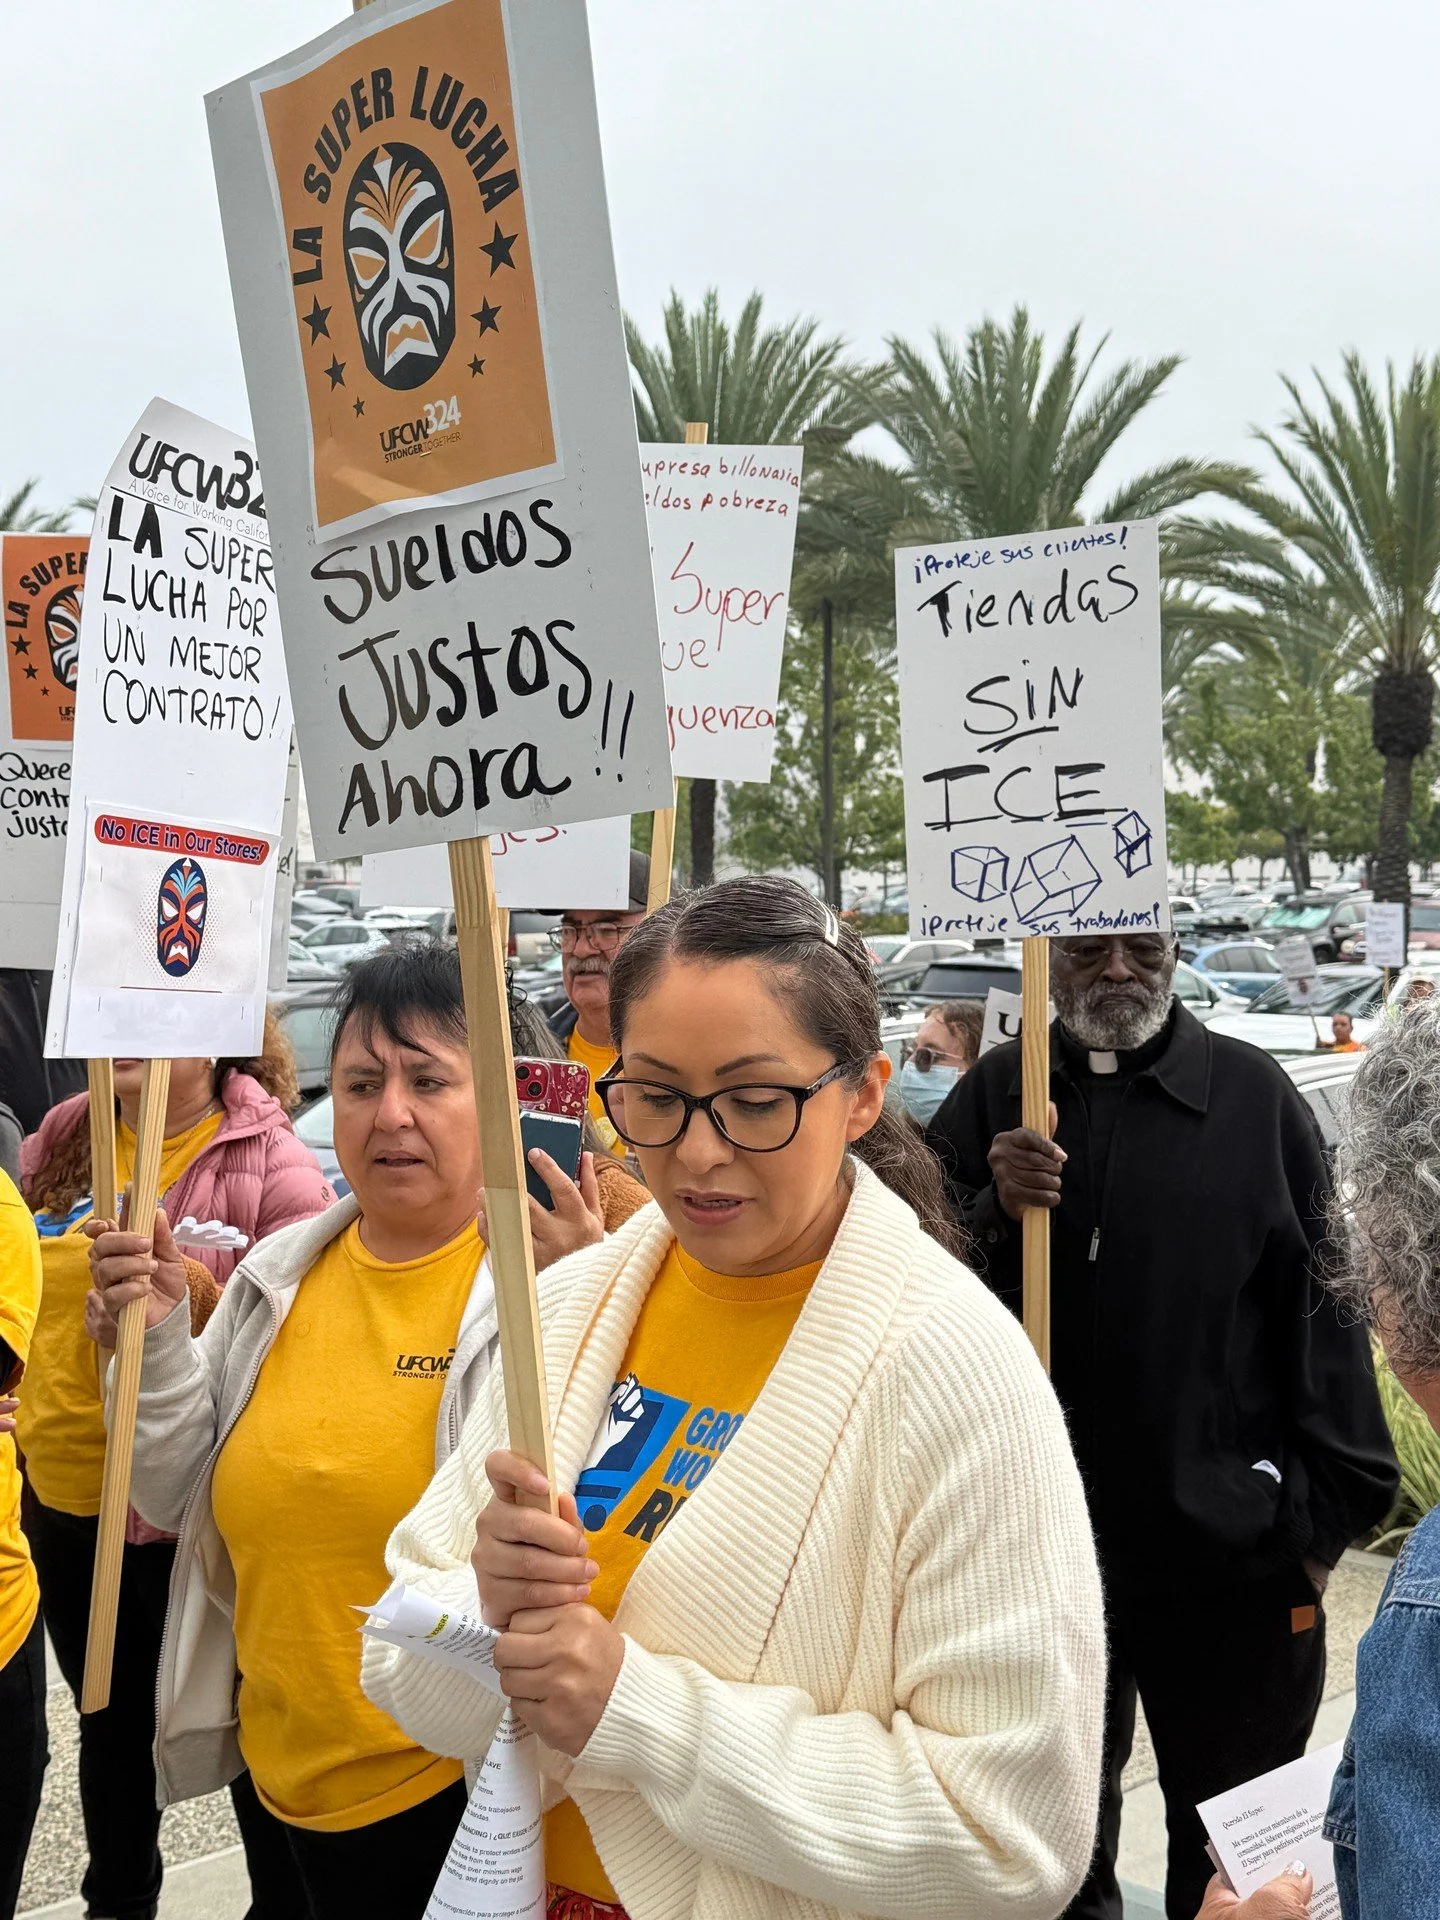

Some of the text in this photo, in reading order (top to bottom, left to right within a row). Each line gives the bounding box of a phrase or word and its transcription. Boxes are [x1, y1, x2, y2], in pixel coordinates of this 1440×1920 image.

[293, 65, 520, 286] LA SUPER LUCHA
[128, 478, 137, 493] A
[141, 482, 170, 504] Voice
[173, 493, 189, 510] for
[192, 500, 233, 531] Working
[108, 494, 275, 593] LA SUPER
[1000, 544, 1034, 564] sus
[6, 600, 31, 628] LA
[103, 547, 267, 637] LUCHA POR
[671, 541, 785, 652] Super
[104, 612, 261, 684] UN MEJOR
[103, 670, 281, 741] CONTRATO!
[338, 619, 592, 750] Justos
[338, 742, 572, 834] Ahora
[922, 763, 1128, 833] ICE
[101, 817, 264, 861] No ICE in Our Stores!
[1029, 920, 1060, 937] sus
